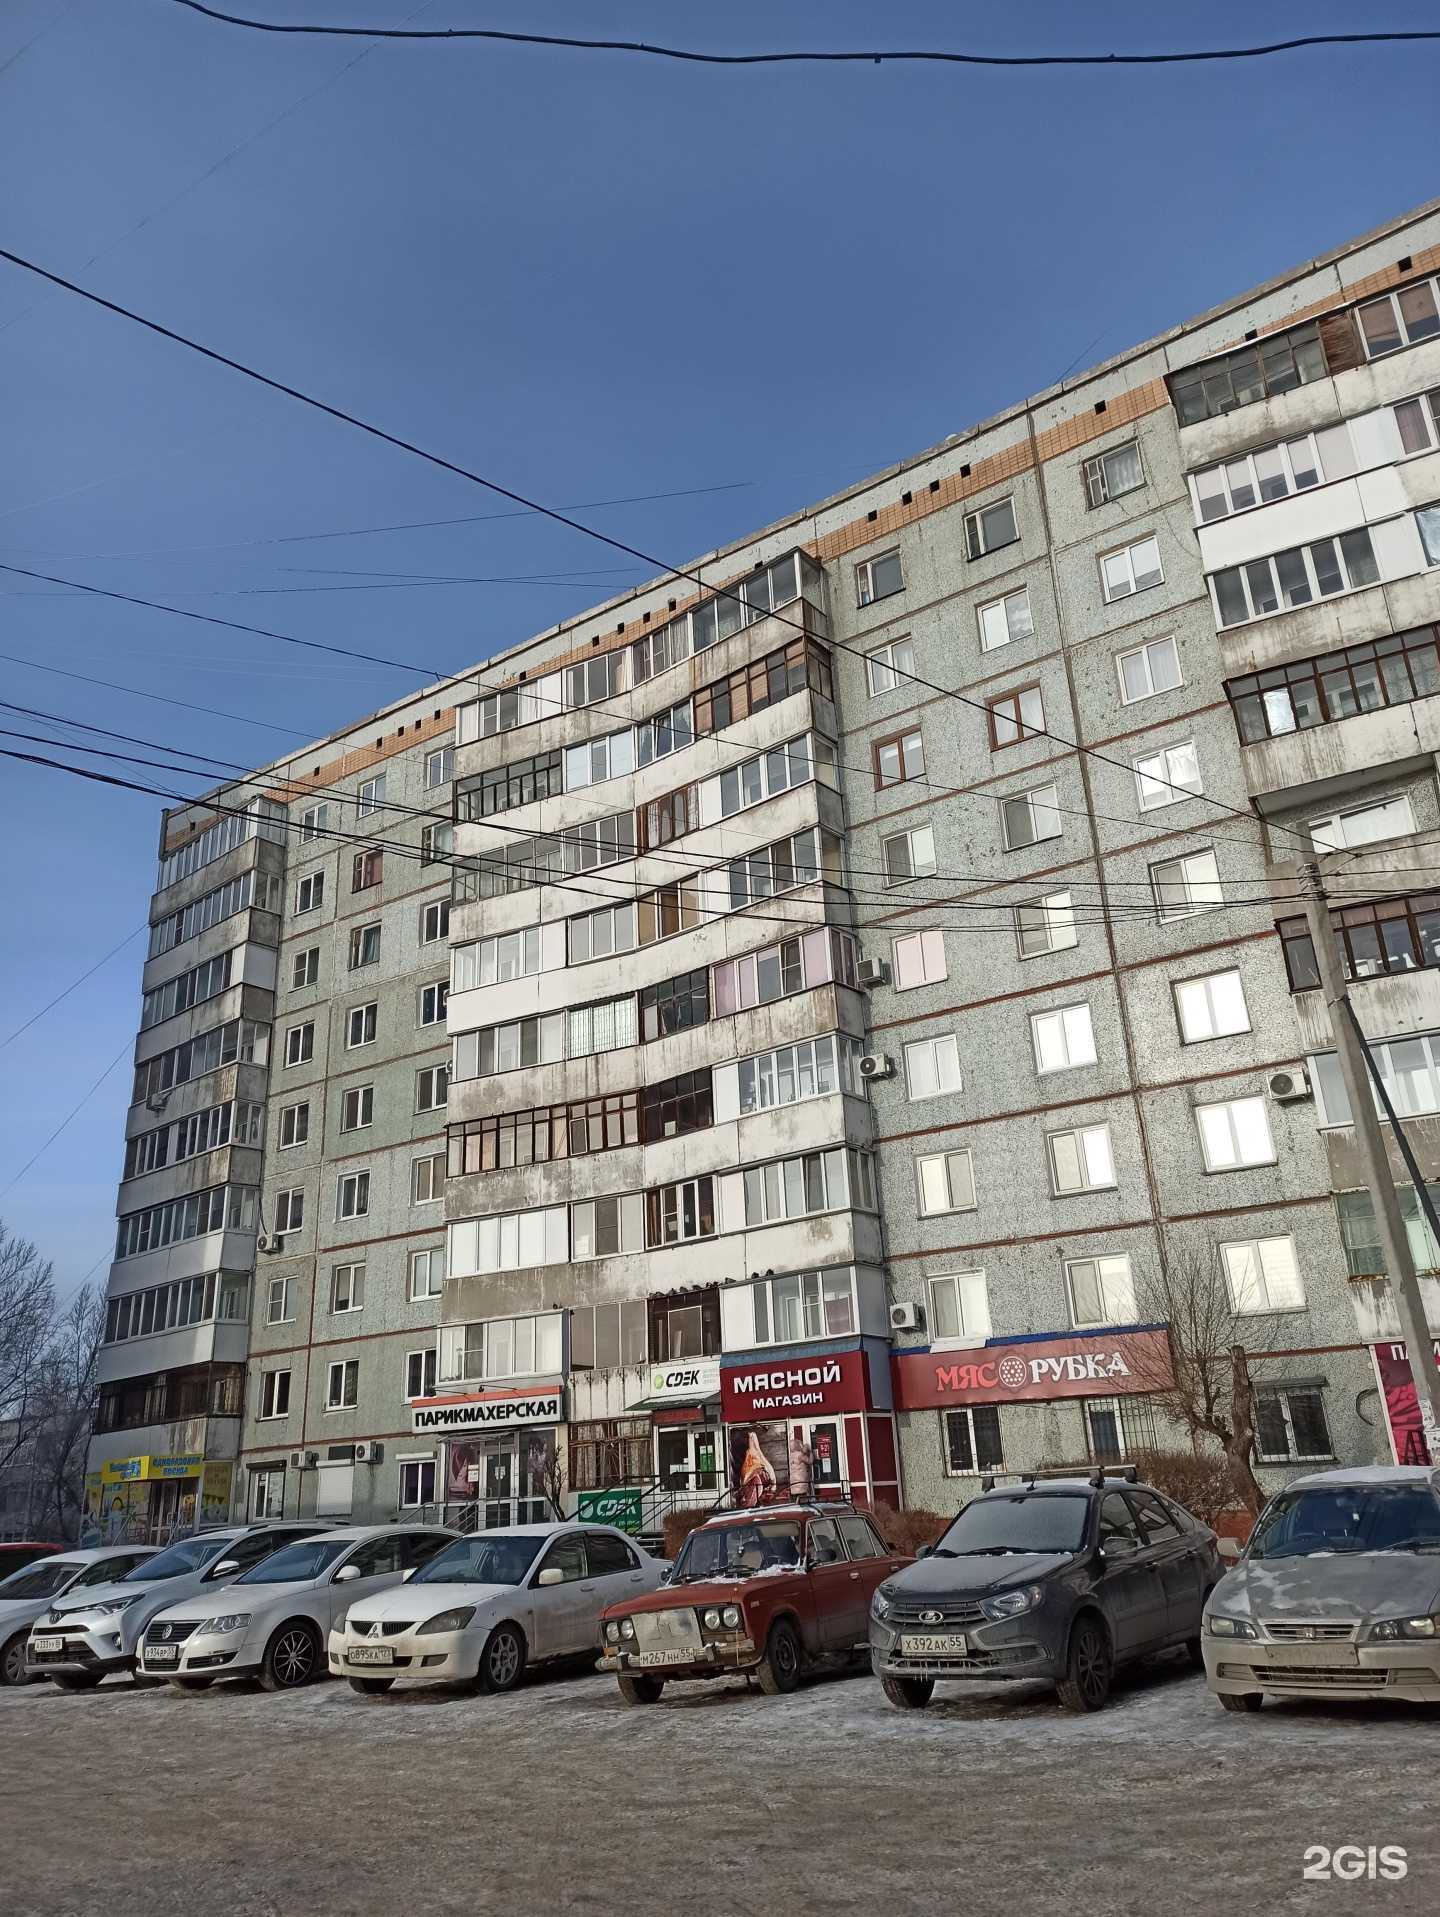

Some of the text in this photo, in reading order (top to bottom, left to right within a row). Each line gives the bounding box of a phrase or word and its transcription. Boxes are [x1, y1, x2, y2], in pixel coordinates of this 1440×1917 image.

[665, 1369, 700, 1388] CDEK
[733, 1360, 841, 1394] МЯСНОЙ
[752, 1391, 823, 1409] МАГАЗИН
[415, 1400, 558, 1427] ПАРИКМАХЕРСКАЯ
[905, 1636, 962, 1651] Х392АК 55
